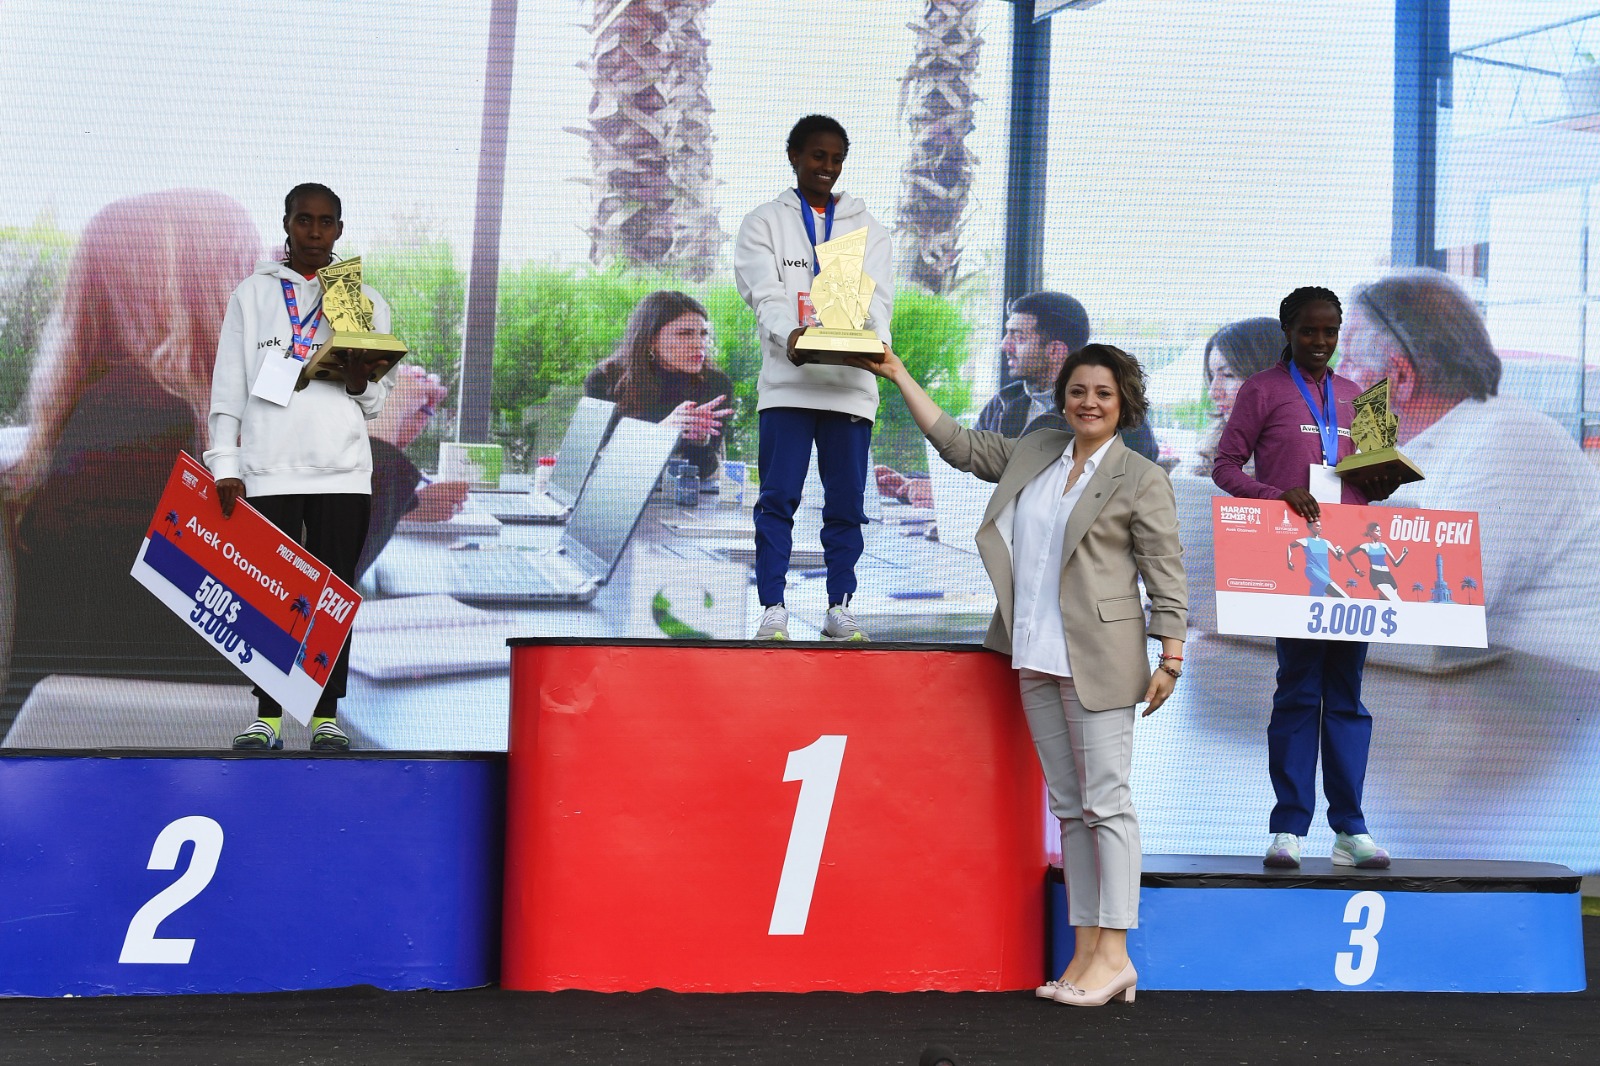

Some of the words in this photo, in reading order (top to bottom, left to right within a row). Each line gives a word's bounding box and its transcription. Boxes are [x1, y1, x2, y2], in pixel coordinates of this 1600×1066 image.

[1220, 505, 1261, 515] MARATON
[1389, 514, 1431, 543] ÖDÜL
[1434, 519, 1473, 548] ÇEKİ
[185, 515, 219, 551] Avek
[222, 541, 290, 602] Otomotiv
[276, 543, 295, 563] PRIZE
[292, 555, 321, 582] VOUCHER
[1229, 579, 1275, 589] maratonizmir.org
[316, 586, 355, 625] ÇEKİ
[767, 735, 848, 937] 1
[118, 815, 224, 965] 2
[1335, 890, 1386, 986] 3
